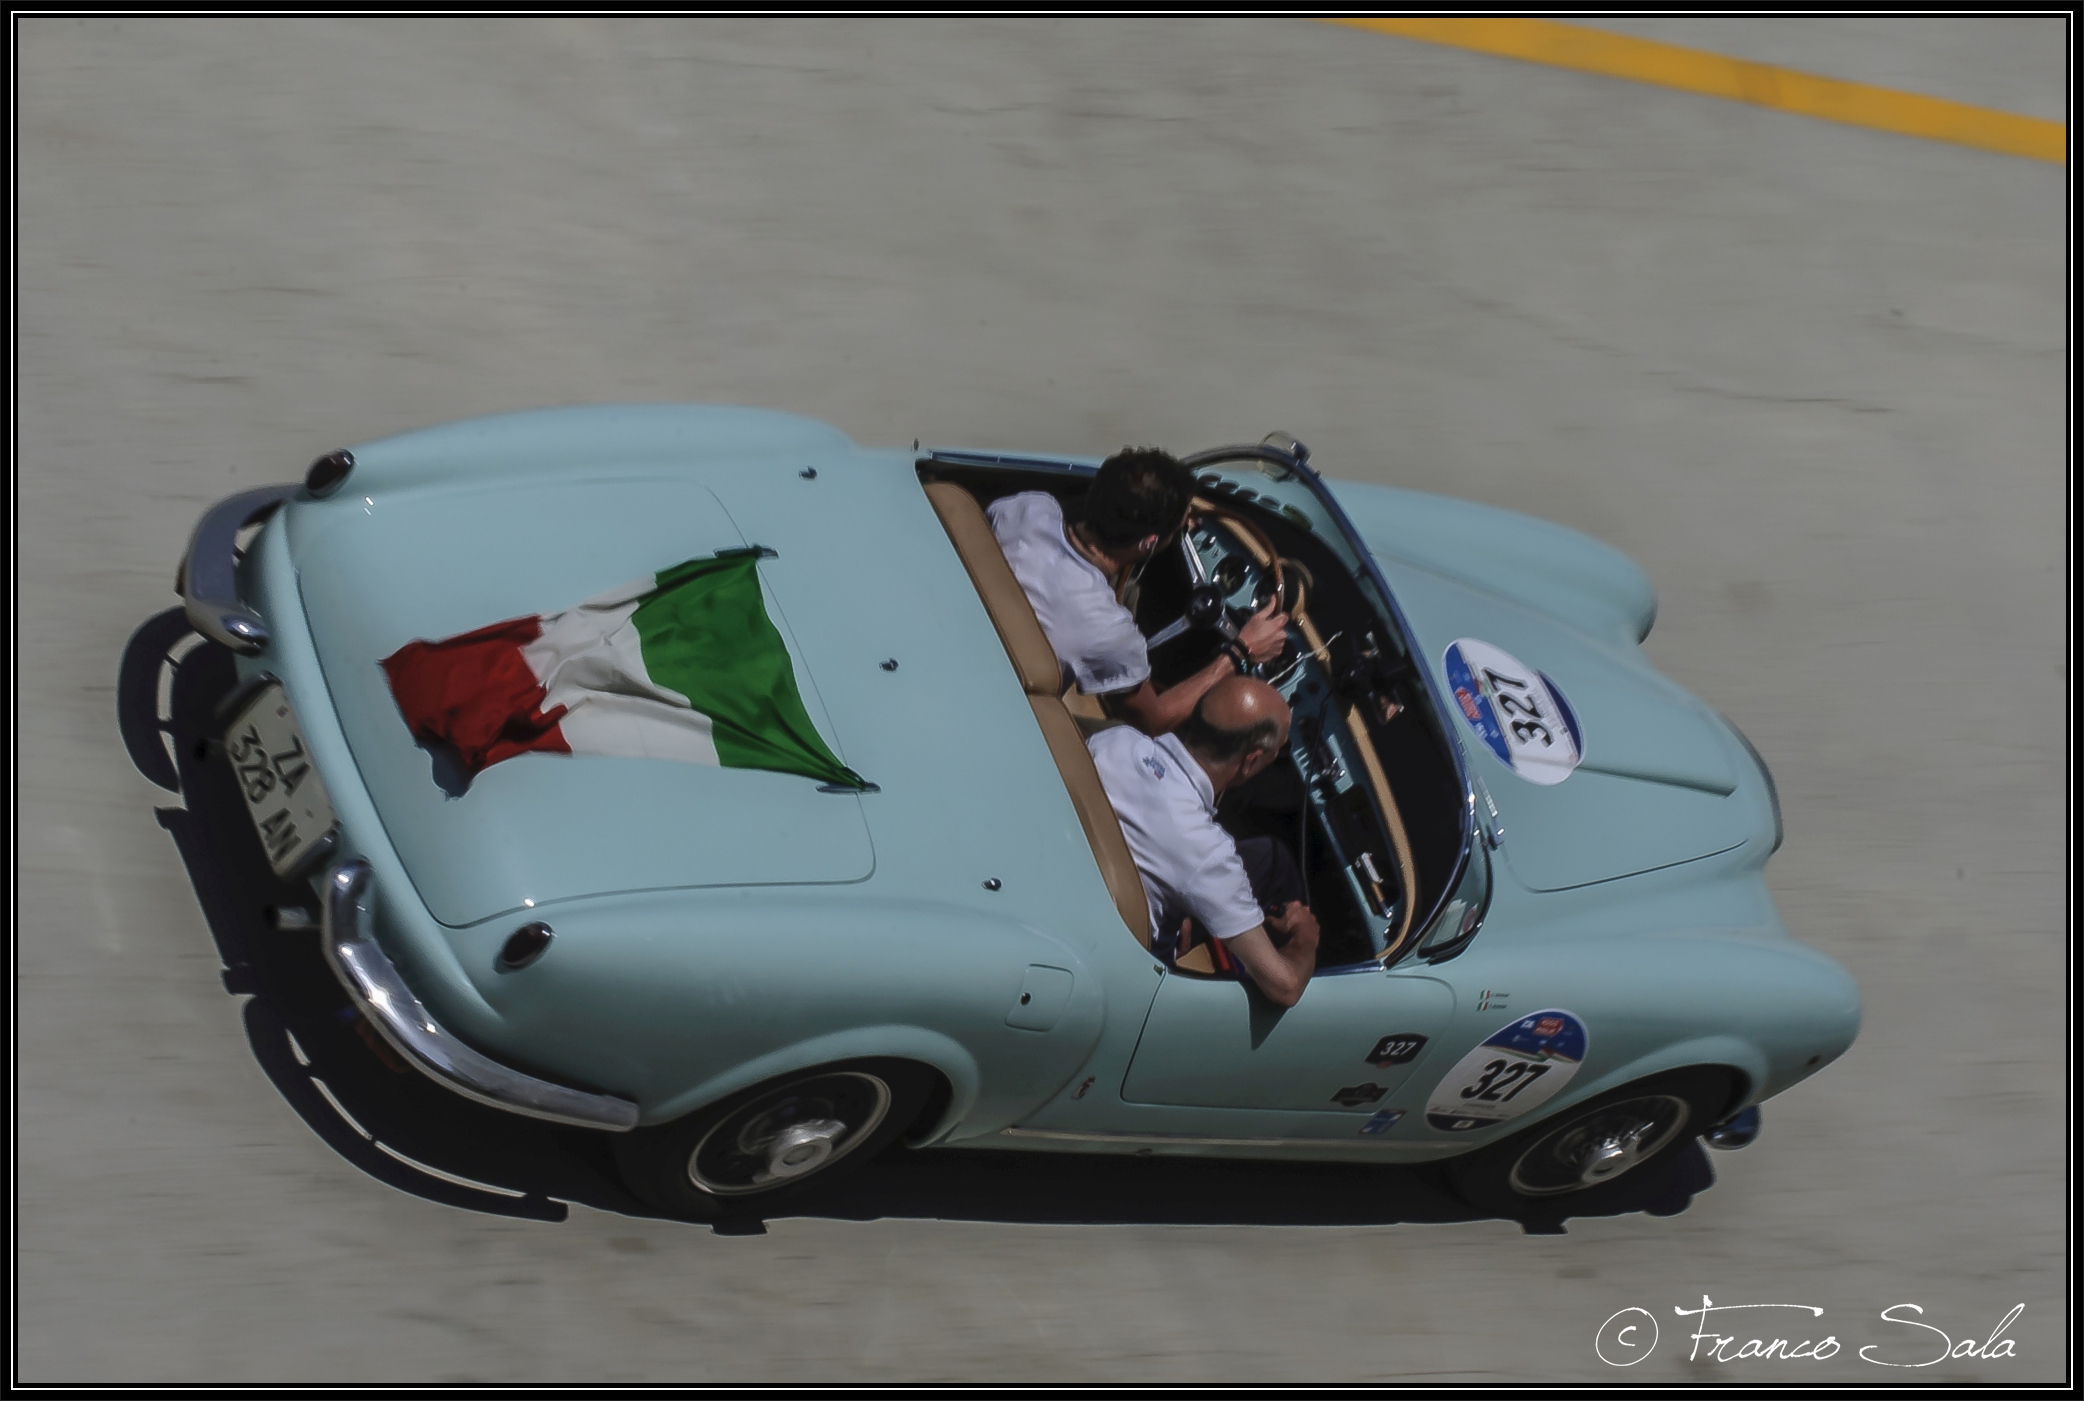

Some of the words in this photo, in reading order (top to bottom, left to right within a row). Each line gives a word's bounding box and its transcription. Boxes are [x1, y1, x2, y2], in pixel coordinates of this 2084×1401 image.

[1483, 667, 1554, 748] 327
[231, 724, 276, 804] 328
[260, 807, 302, 864] AN
[269, 732, 311, 798] ZA
[1380, 1041, 1418, 1056] 327
[1459, 1059, 1552, 1102] 327
